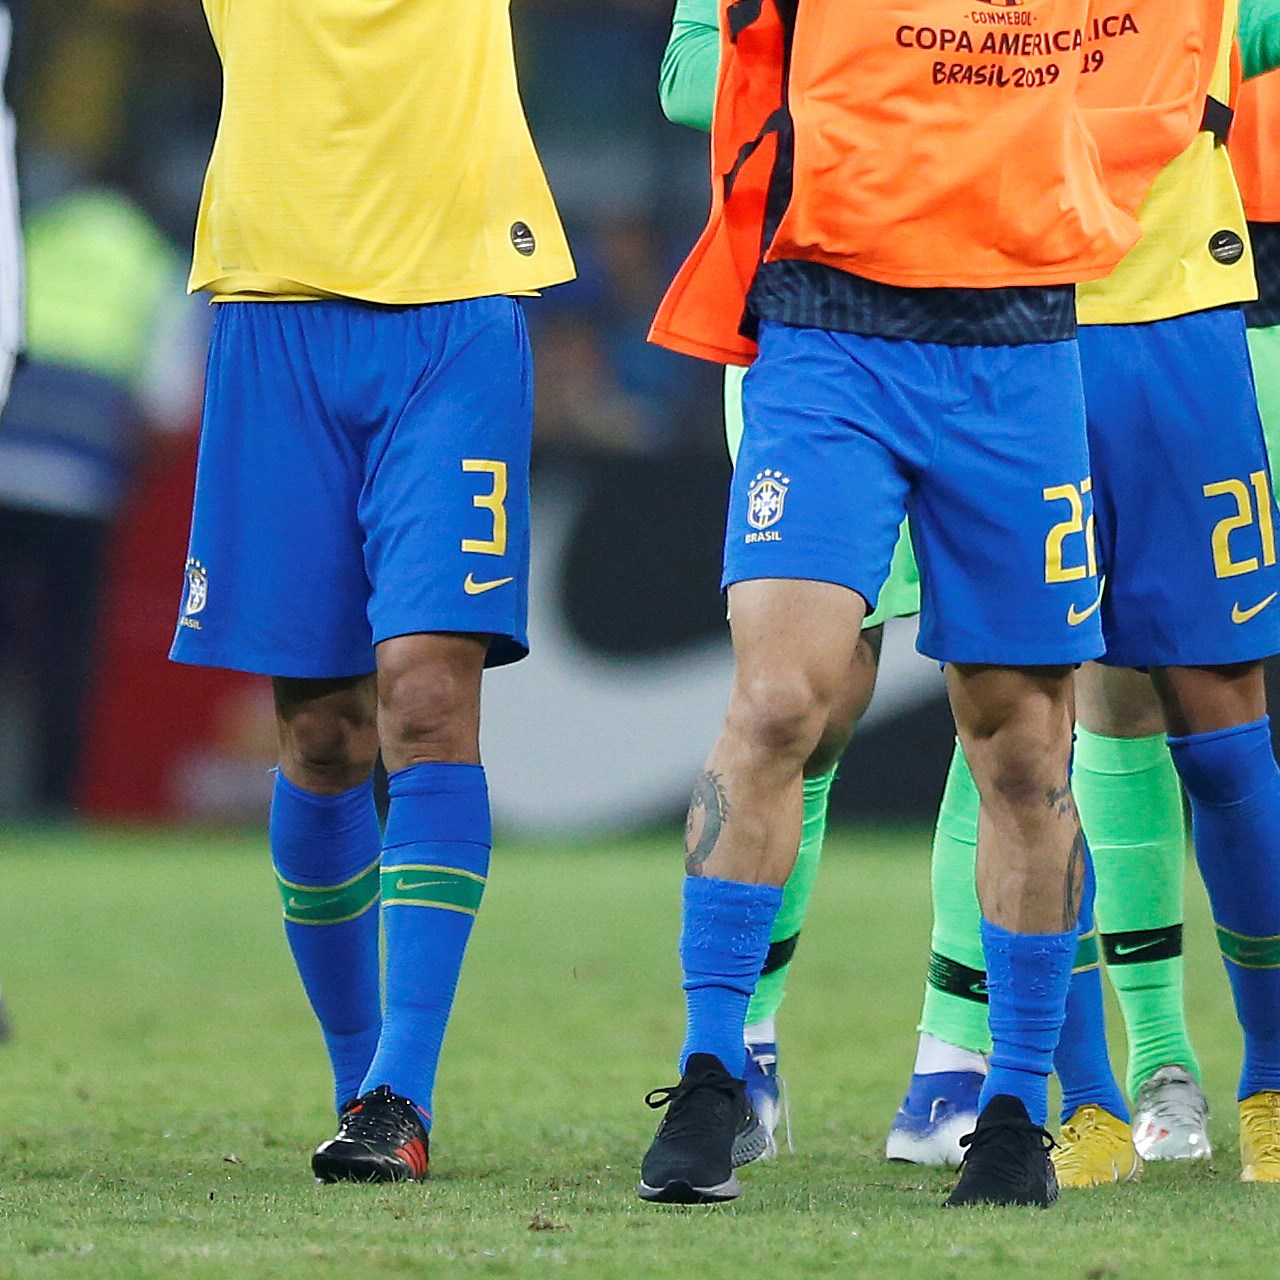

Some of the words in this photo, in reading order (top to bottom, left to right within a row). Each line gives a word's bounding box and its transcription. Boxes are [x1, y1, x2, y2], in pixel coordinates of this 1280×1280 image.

[895, 24, 974, 55] COPA
[978, 27, 1083, 57] AMERICA
[1011, 63, 1061, 89] 2019
[461, 458, 508, 556] 3
[743, 530, 784, 545] BRASIL
[1202, 469, 1278, 580] 21
